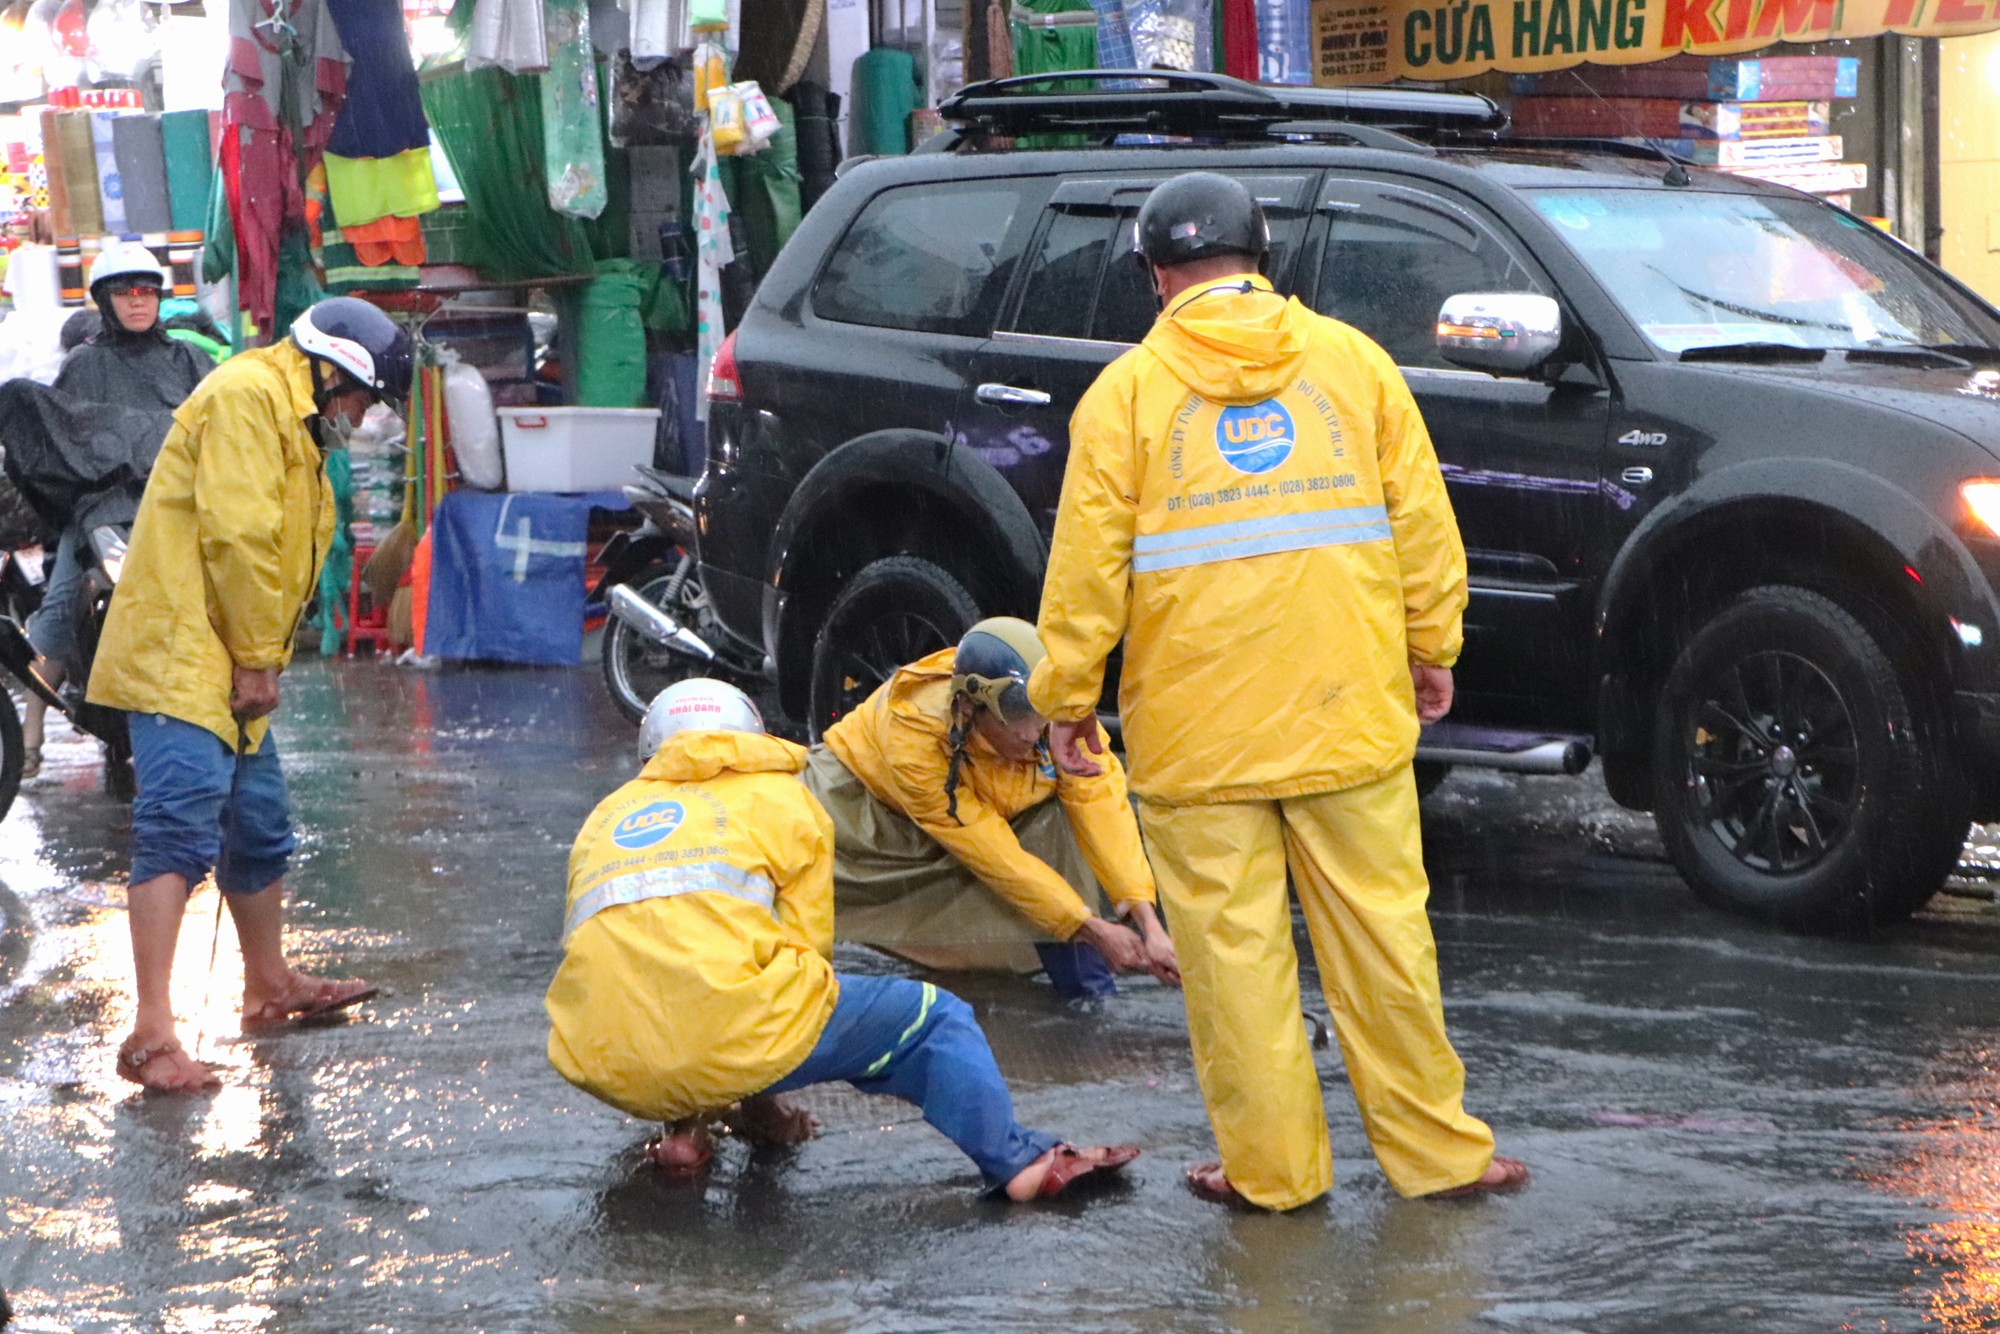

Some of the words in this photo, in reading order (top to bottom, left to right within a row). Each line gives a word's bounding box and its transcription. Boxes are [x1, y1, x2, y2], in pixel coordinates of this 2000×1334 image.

[1174, 427, 1186, 443] TY
[1223, 413, 1286, 443] UDC
[1618, 429, 1667, 446] 4WD
[1167, 496, 1186, 511] ĐT:
[1188, 492, 1215, 511] (028)
[1217, 486, 1242, 504] 3823
[1245, 483, 1270, 499] 4444
[1279, 478, 1305, 496] (028)
[1307, 475, 1331, 492] 3823
[1332, 472, 1356, 489] 0800
[622, 808, 678, 831] UDC
